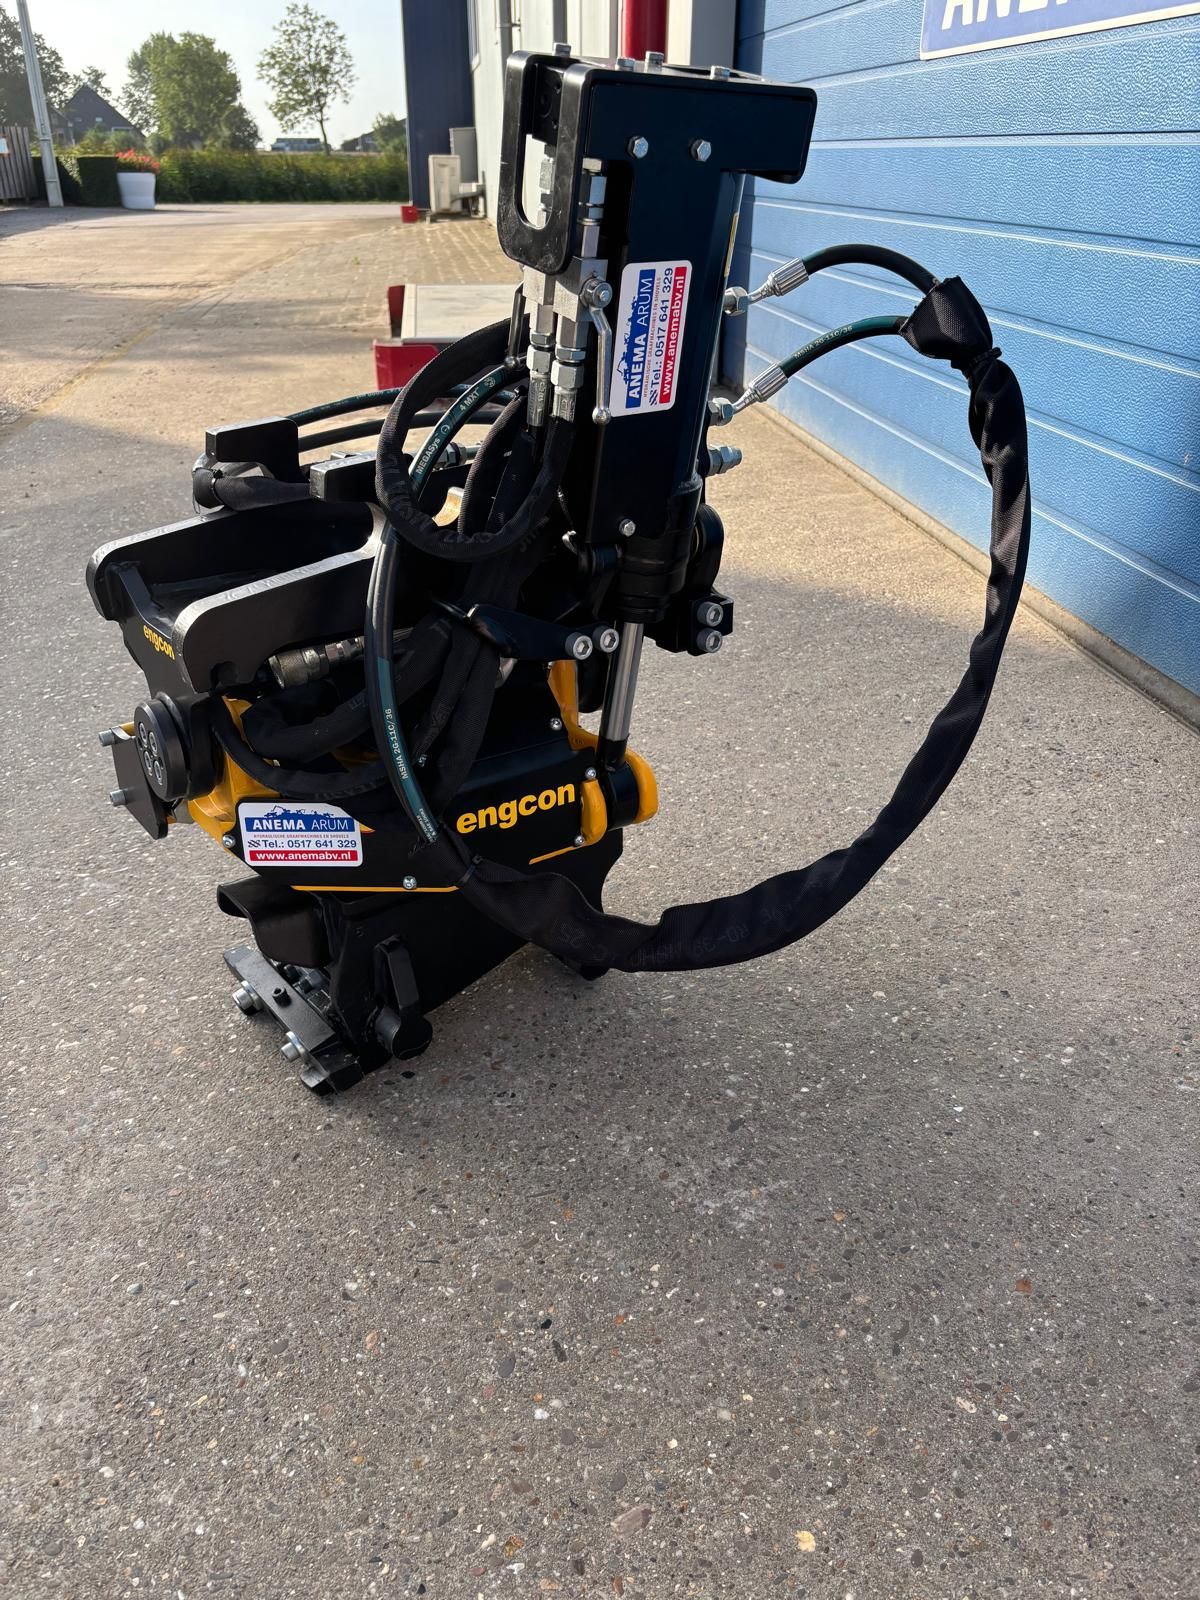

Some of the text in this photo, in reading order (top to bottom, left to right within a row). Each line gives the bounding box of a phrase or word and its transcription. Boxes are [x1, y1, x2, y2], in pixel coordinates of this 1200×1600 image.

[628, 278, 653, 399] ANEMA ARUM
[651, 267, 674, 388] Tel.: 0517 641 329
[663, 275, 685, 396] www.anemabv.nl
[143, 624, 176, 660] engcon
[395, 753, 409, 780] MSHA
[252, 819, 349, 830] ANEMA ARUM
[456, 783, 576, 834] engcon
[256, 851, 351, 860] www.anemabv.nl
[262, 840, 357, 848] Tel.: 0517 641 329
